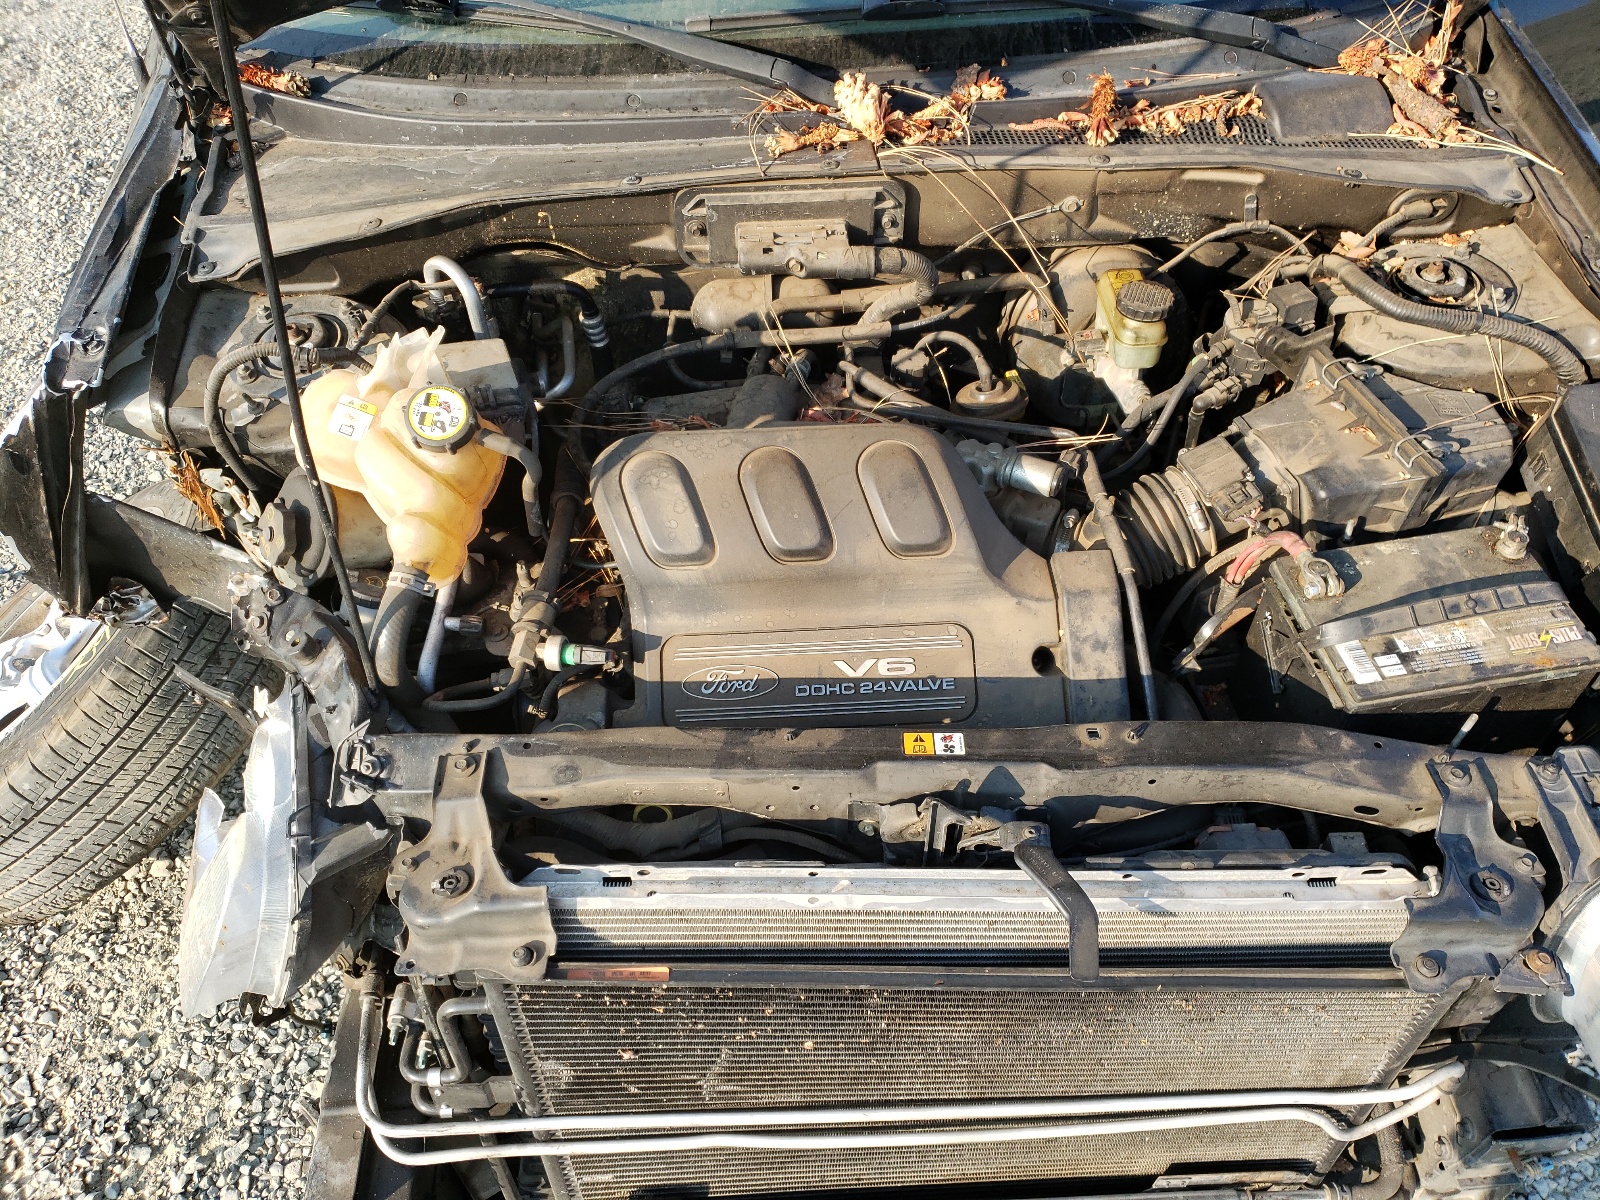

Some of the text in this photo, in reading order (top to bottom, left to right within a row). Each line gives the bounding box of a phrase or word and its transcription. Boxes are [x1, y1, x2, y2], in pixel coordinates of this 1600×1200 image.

[1505, 625, 1583, 651] PLUS START
[833, 656, 917, 678] V6
[700, 668, 761, 694] Ford
[795, 677, 956, 697] DOHC 24-VALVE
